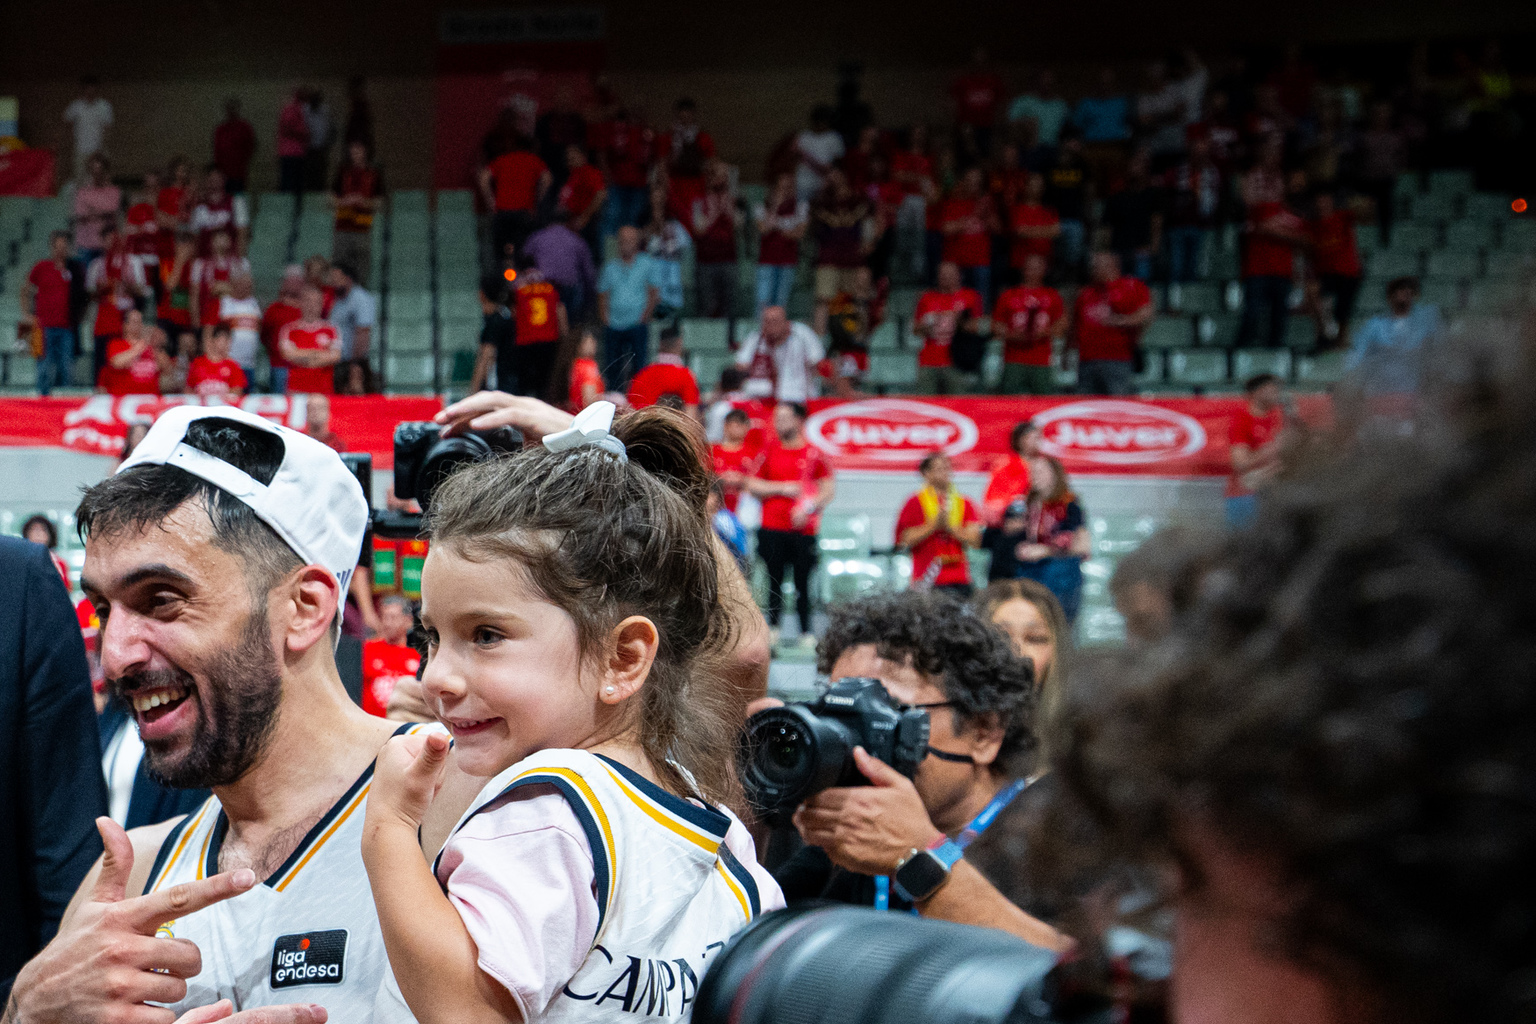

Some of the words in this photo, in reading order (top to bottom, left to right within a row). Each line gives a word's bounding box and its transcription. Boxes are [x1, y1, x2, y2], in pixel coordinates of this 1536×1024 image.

[830, 417, 958, 447] Juver
[1054, 418, 1181, 448] Juver
[277, 950, 306, 968] liga
[275, 963, 340, 982] endesa
